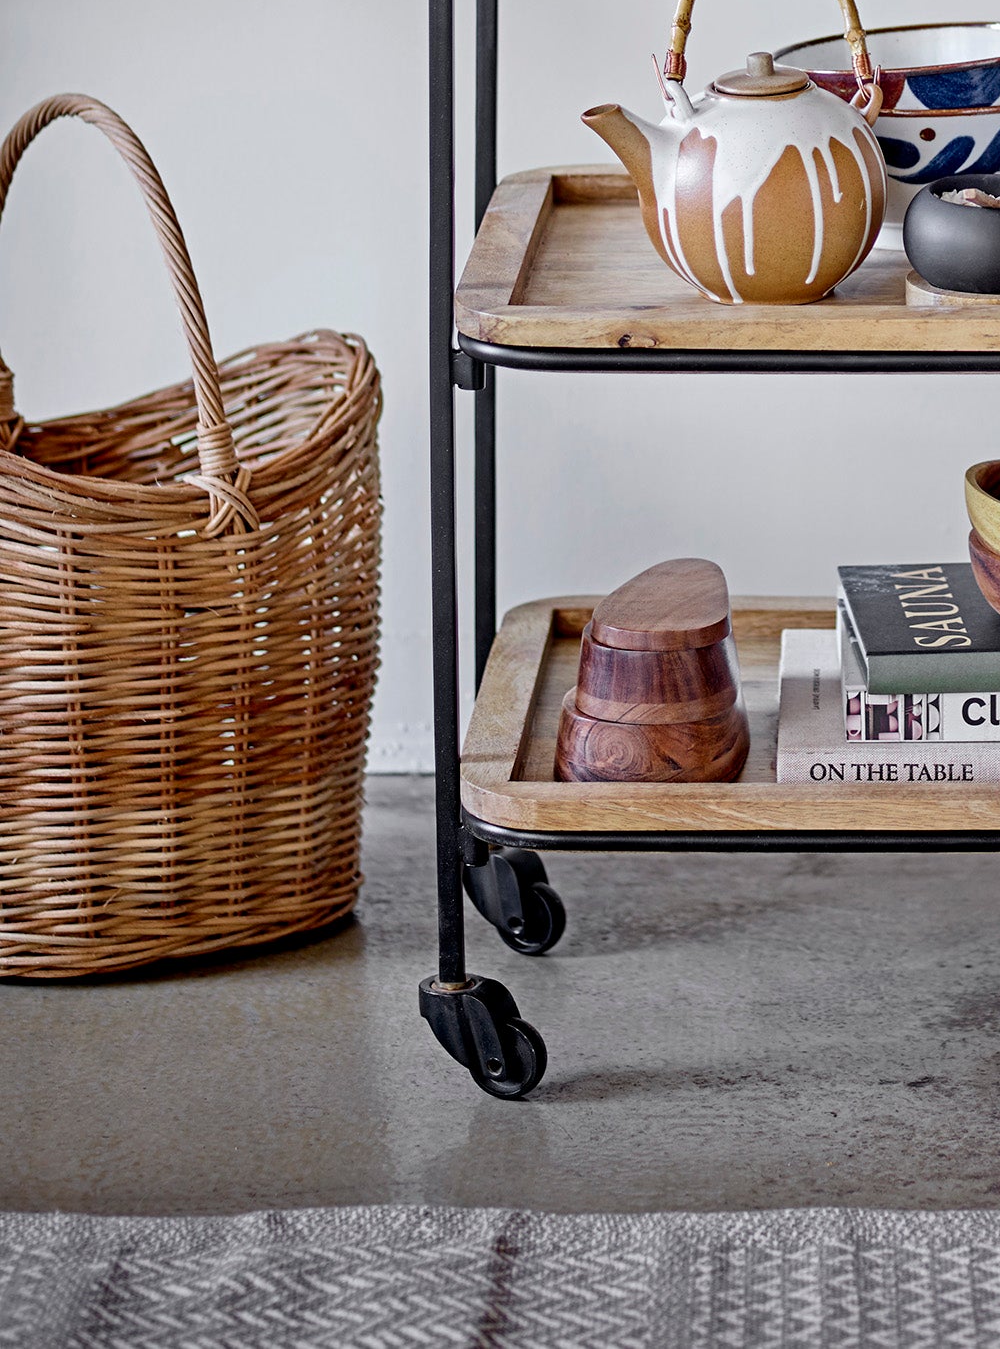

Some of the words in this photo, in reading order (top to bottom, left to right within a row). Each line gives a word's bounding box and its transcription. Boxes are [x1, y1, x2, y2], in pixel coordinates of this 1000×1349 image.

[890, 566, 972, 648] SAUNA
[809, 763, 846, 782] ON
[850, 763, 899, 782] THE
[903, 763, 974, 782] TABLE
